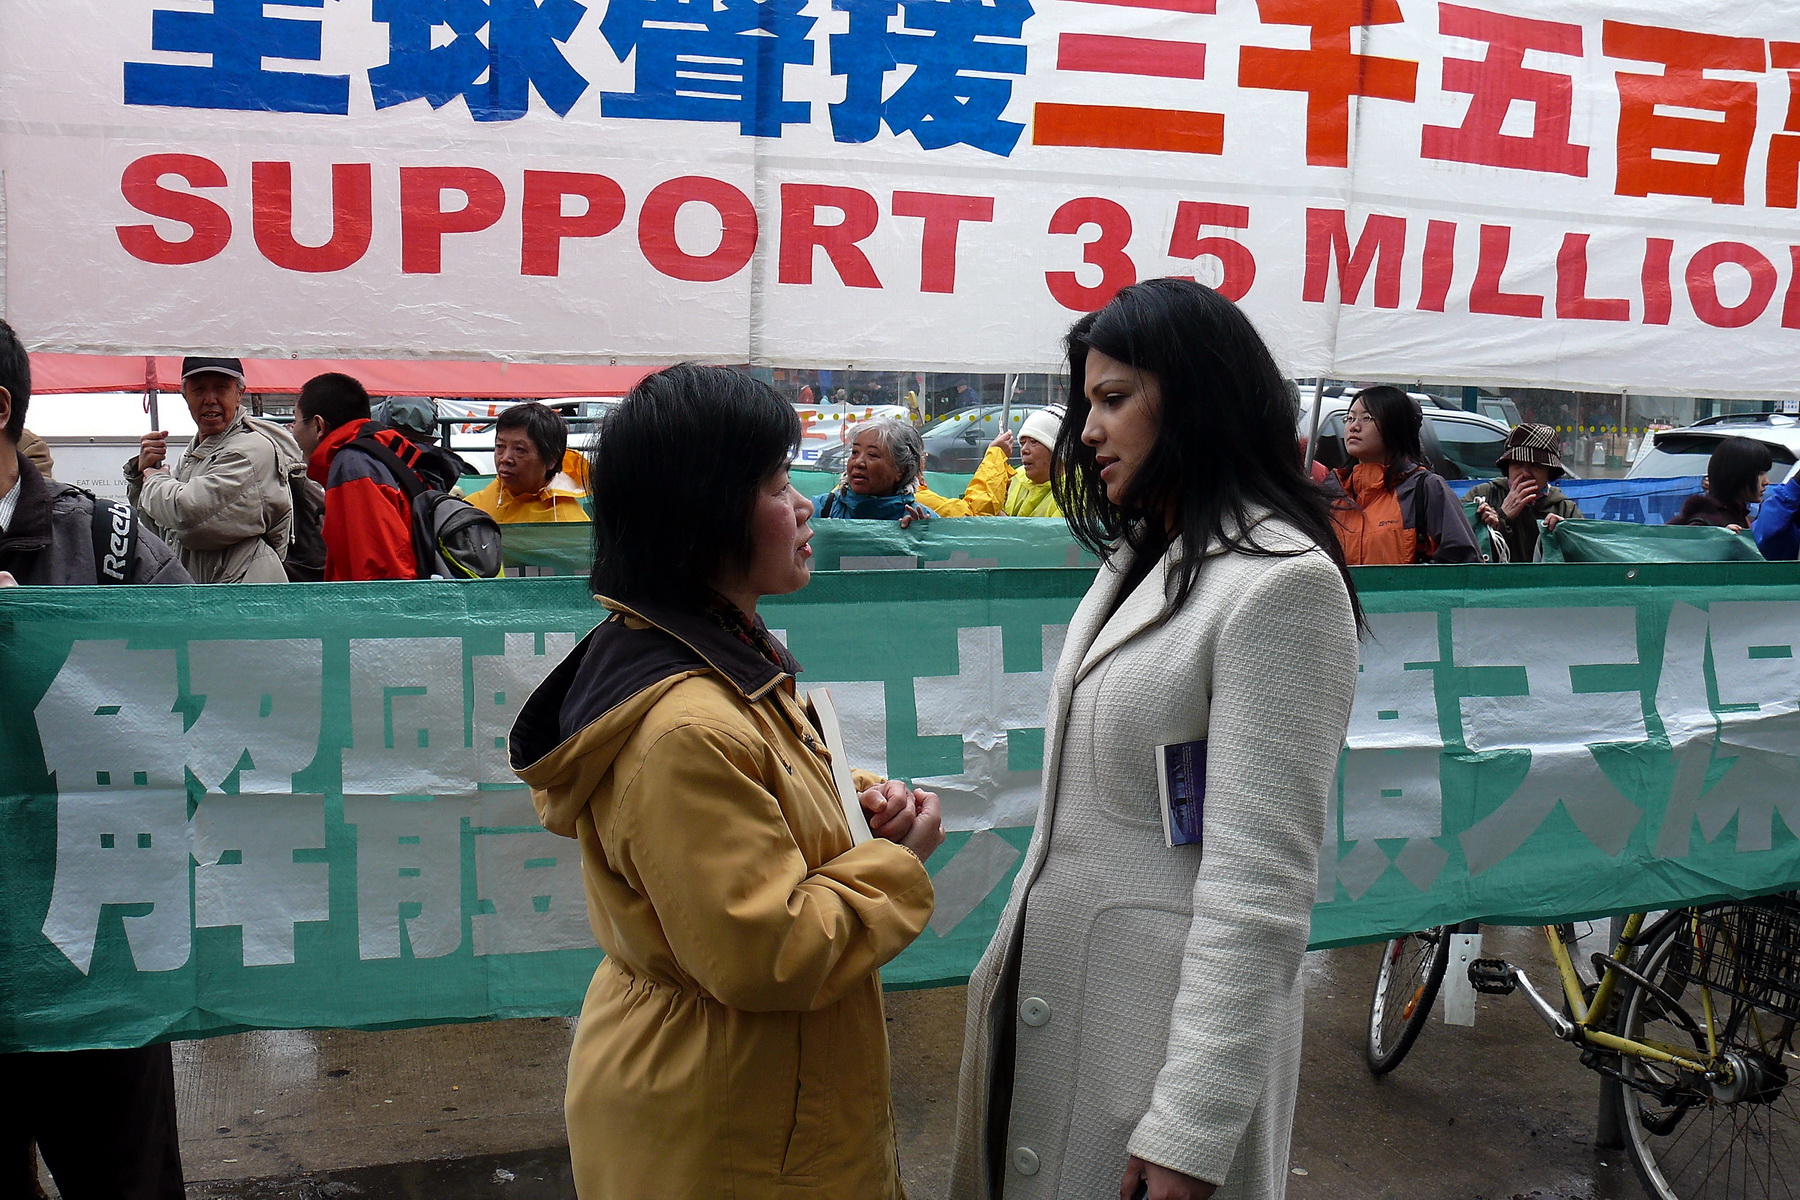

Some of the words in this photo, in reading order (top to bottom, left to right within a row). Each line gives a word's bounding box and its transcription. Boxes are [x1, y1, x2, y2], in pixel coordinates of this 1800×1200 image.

[115, 153, 994, 293] SUPPORT
[1045, 196, 1257, 312] 35
[1302, 207, 1800, 329] MILLIO
